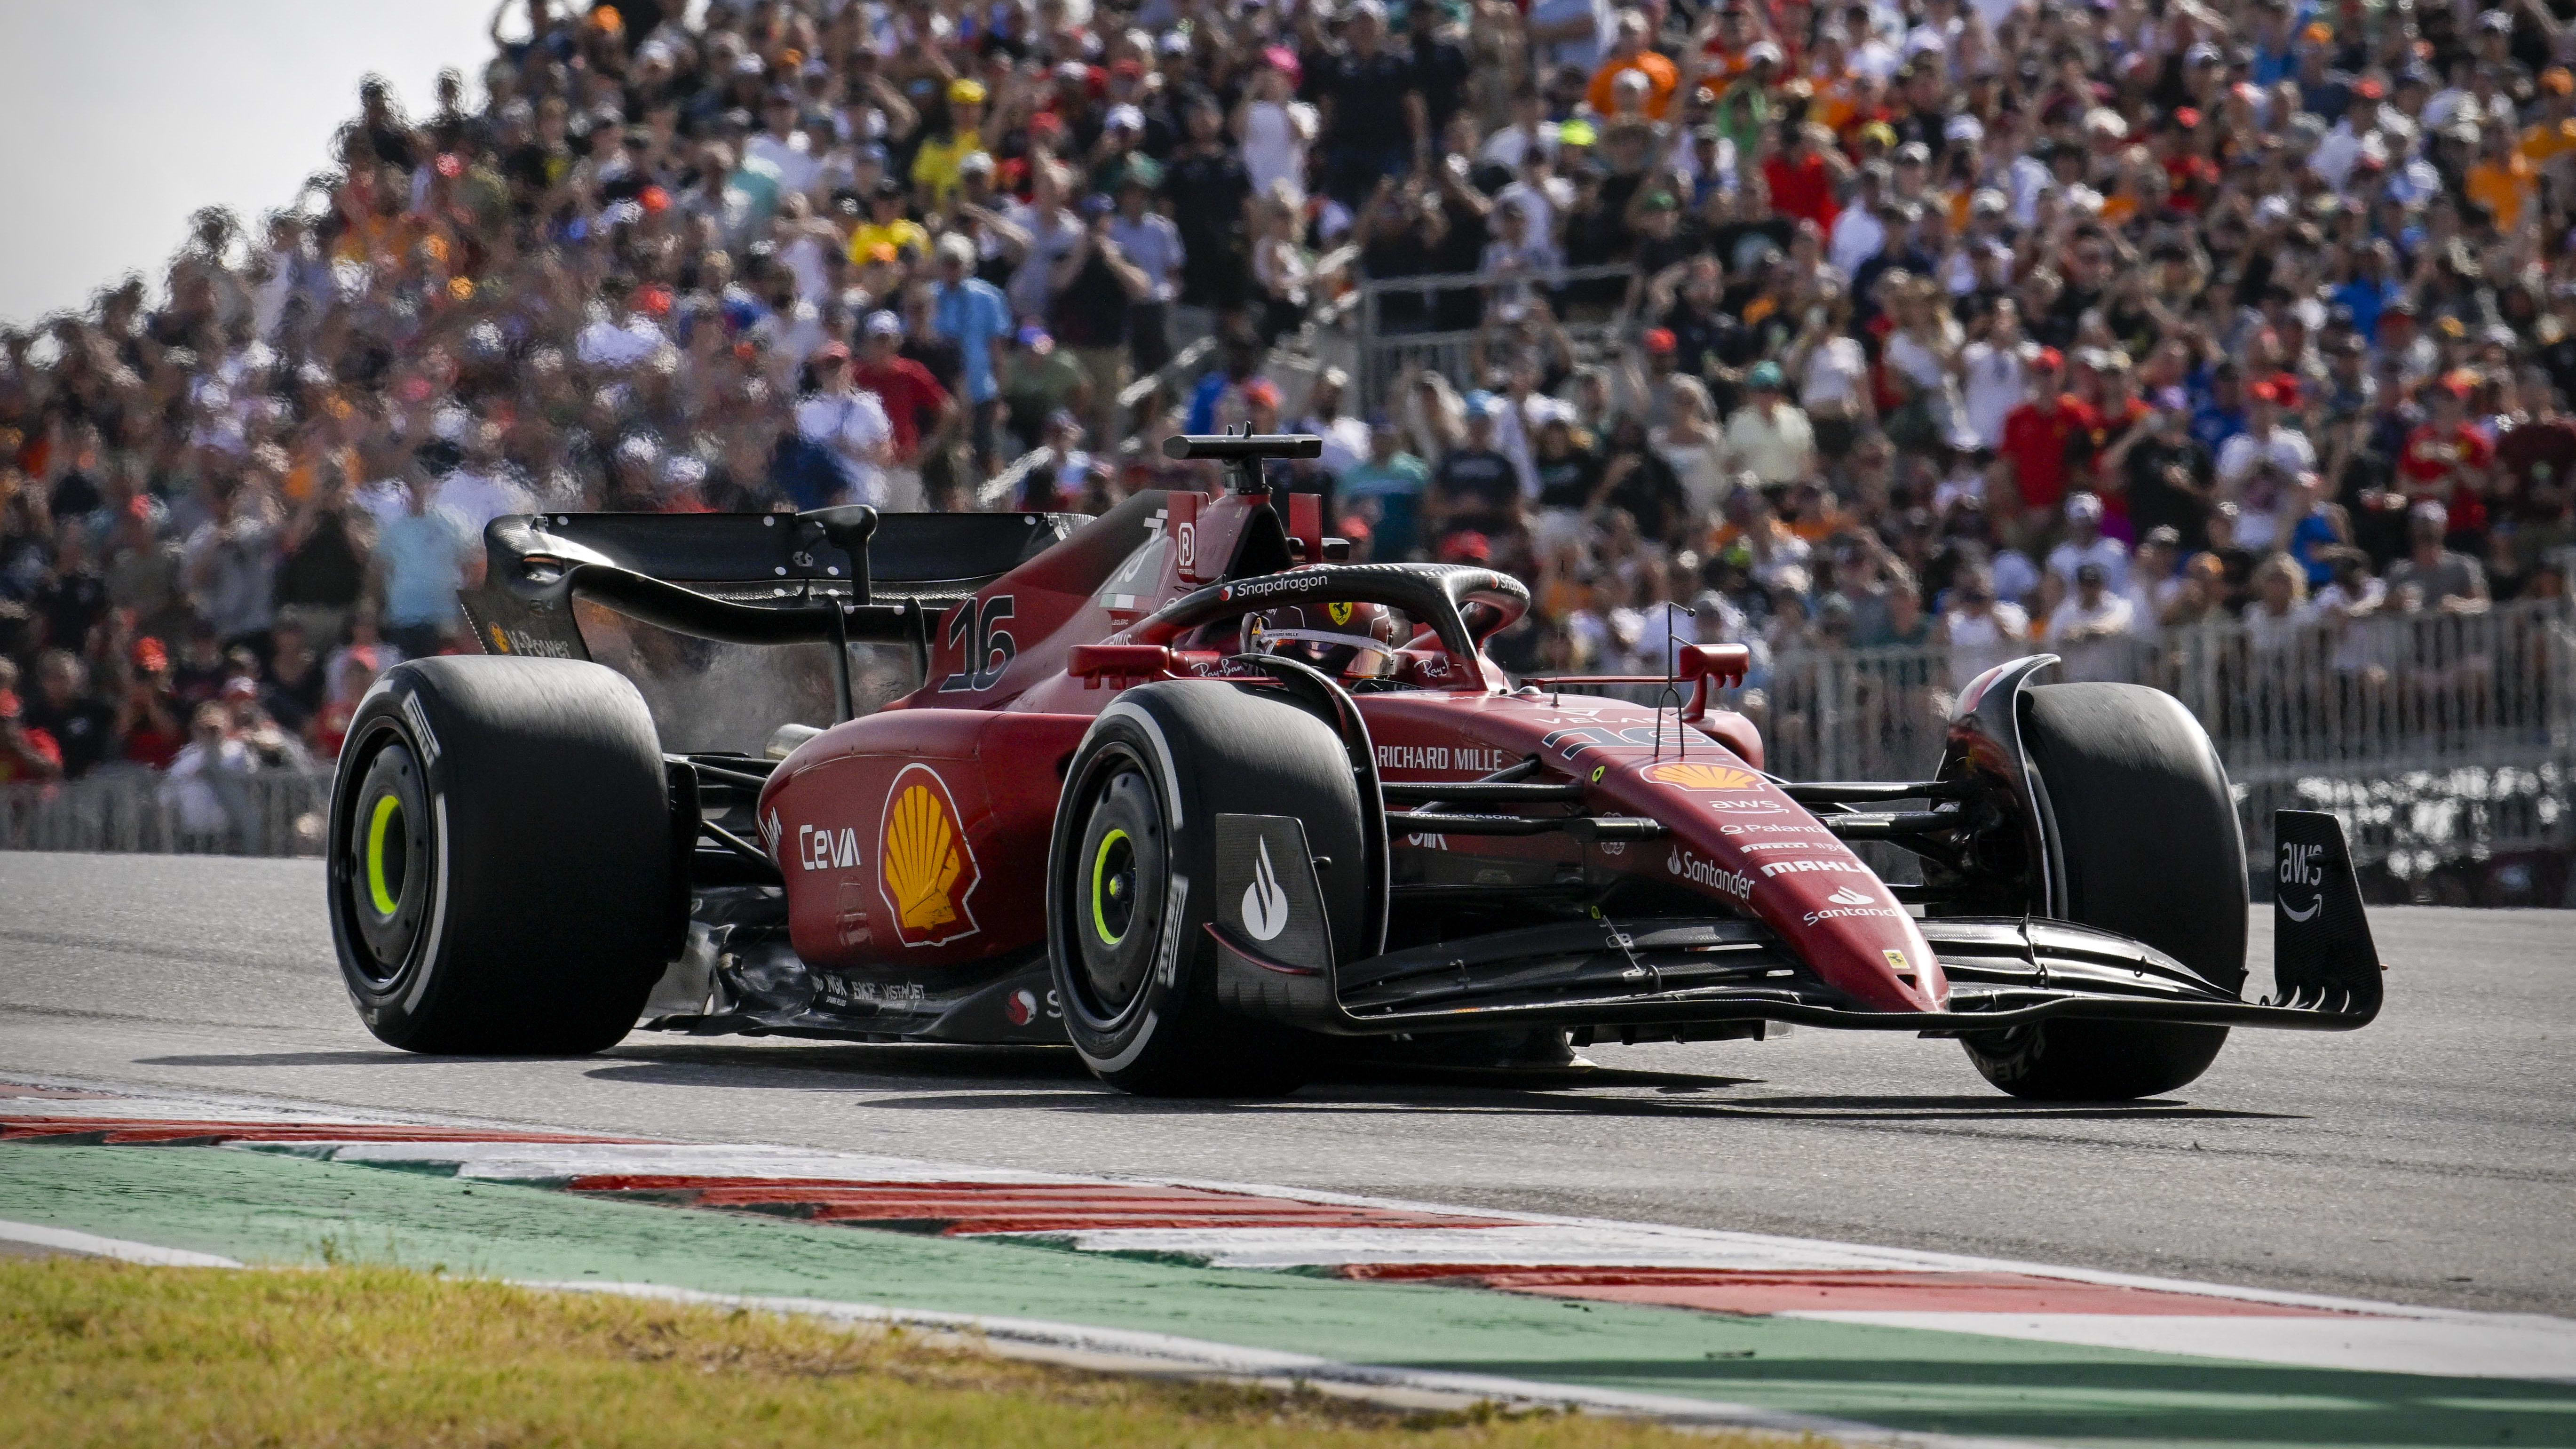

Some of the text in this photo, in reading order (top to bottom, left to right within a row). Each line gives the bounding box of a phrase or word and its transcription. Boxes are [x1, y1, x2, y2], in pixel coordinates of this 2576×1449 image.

[1237, 575, 1328, 597] Snapdragon
[938, 595, 1016, 693] 16
[1378, 746, 1502, 771] RICHARD MILLE
[1542, 727, 1721, 761] 16
[1709, 800, 1781, 809] aws
[1683, 851, 1755, 900] Santander
[2280, 842, 2322, 886] aws
